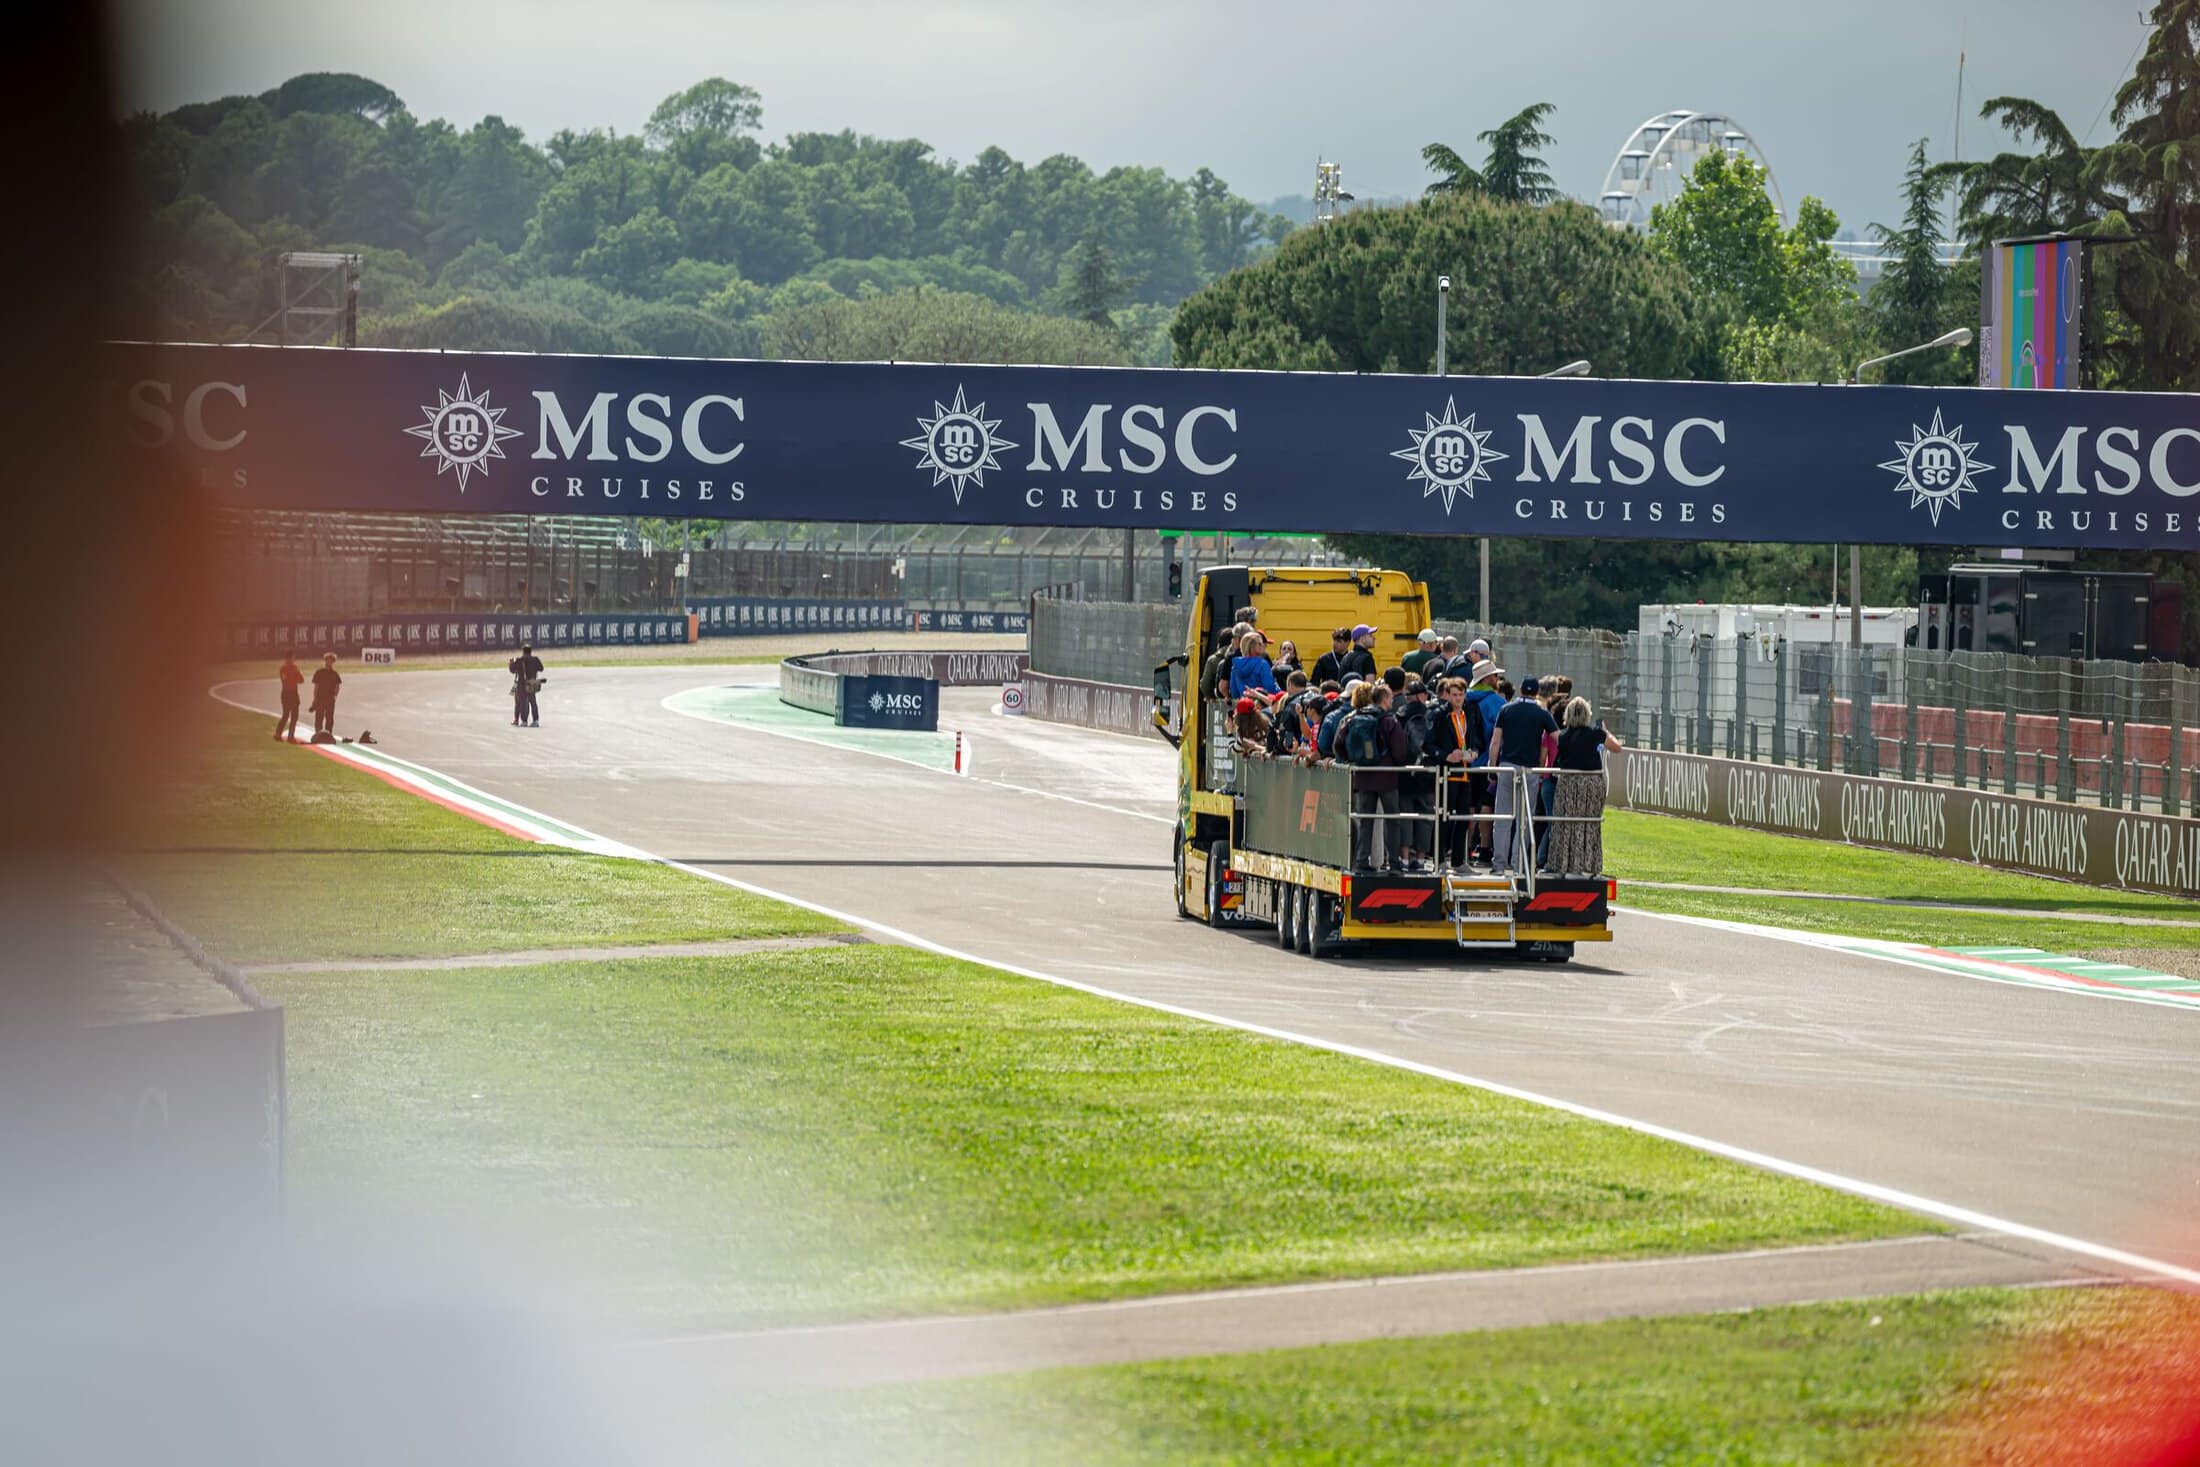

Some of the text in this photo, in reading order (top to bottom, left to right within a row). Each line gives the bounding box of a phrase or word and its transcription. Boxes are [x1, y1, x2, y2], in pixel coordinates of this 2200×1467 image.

[531, 390, 745, 465] MSC
[1025, 402, 1238, 476] MSC
[1515, 413, 1726, 487] MSC
[531, 476, 745, 502] CRUISES
[2002, 424, 2200, 497] MSC
[1025, 487, 1237, 512] CRUISES
[1515, 498, 1725, 524] CRUISES
[2001, 509, 2200, 533] CRUISE
[364, 652, 391, 664] DRS
[948, 654, 1019, 684] QATAR AIRWAYS
[886, 693, 922, 710] MSC
[1006, 693, 1019, 703] 60
[1626, 753, 1662, 809] QATAR
[1663, 758, 1709, 815] AIRWAYS
[1727, 767, 1821, 832] QATAR AIRWAYS
[1841, 781, 1946, 850] QATAR AIRWAYS
[1969, 798, 2088, 876] QATAR AIRWAYS
[2115, 817, 2171, 888] QATAR
